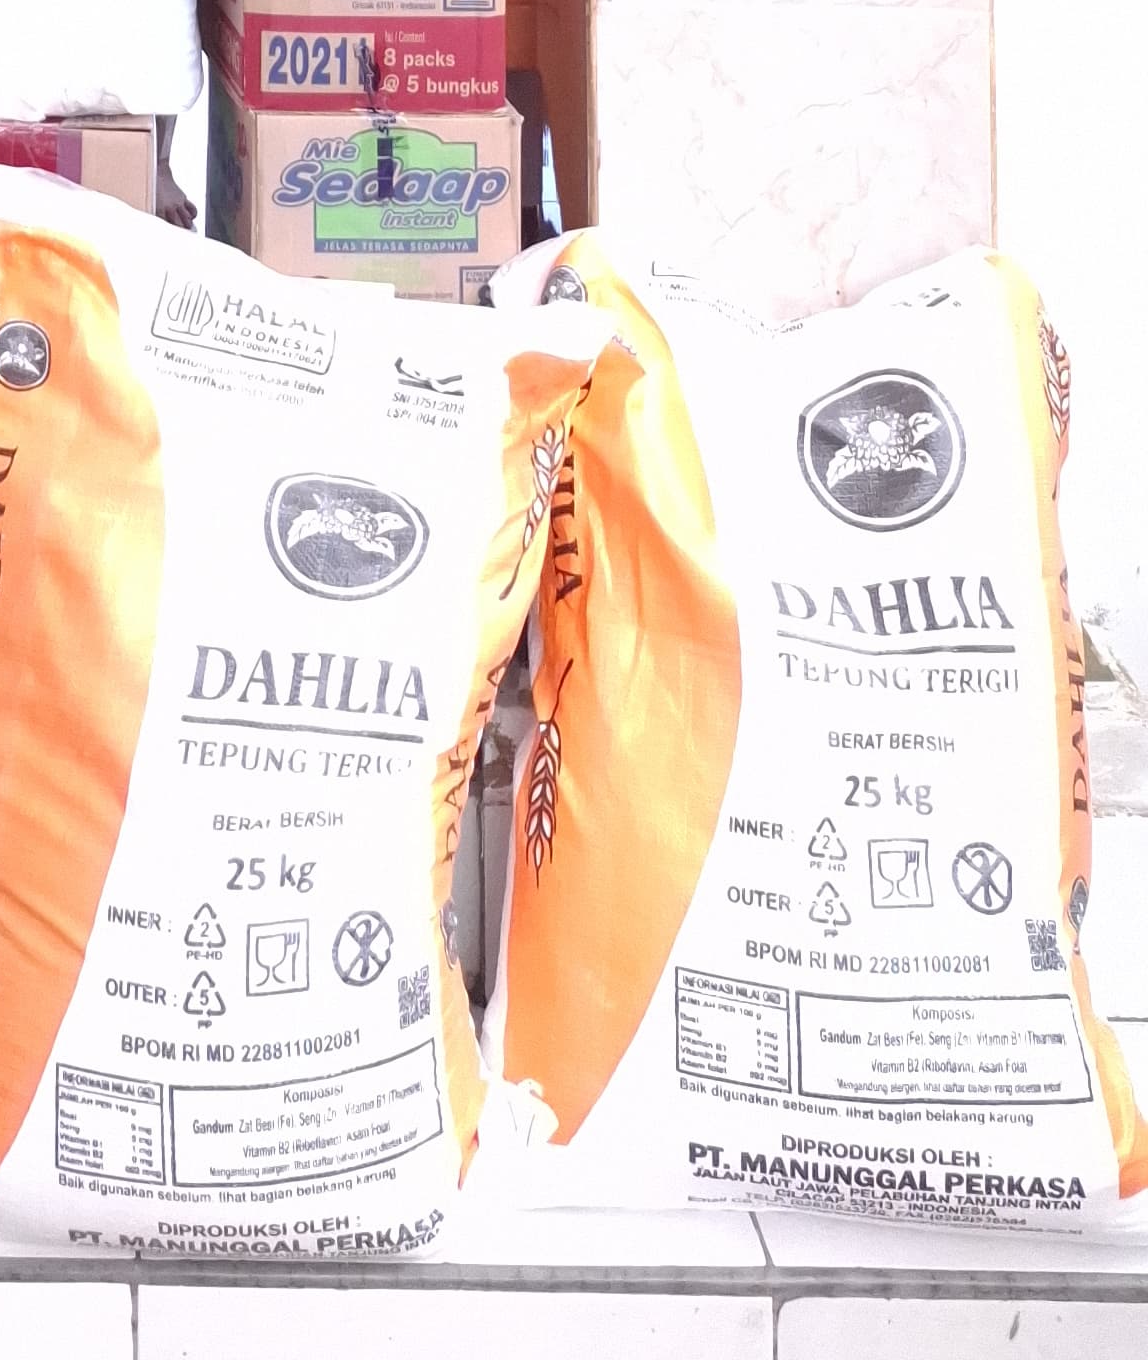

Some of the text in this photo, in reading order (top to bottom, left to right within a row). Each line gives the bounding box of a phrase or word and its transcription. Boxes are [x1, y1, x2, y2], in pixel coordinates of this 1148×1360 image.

[383, 48, 456, 70] 8 packs
[406, 74, 419, 93] 5
[426, 76, 500, 97] bungkus
[302, 137, 360, 161] Mie
[380, 209, 459, 230] Instant
[323, 240, 470, 252] JELAS TERASA SEDAPNYA
[214, 319, 325, 356] INDONESIA
[771, 576, 1015, 636] DAHLIA
[187, 644, 429, 721] DAHLIA
[778, 652, 1019, 693] TEPUNG TERIGU
[828, 731, 955, 753] BERAT BERSIH
[178, 738, 307, 774] TEPUNG
[844, 773, 933, 816] 25 kg
[279, 810, 344, 829] BERSIH
[728, 815, 784, 841] INNER
[821, 834, 831, 851] 2
[226, 853, 317, 894] 25 kg
[727, 885, 791, 912] OUTER
[824, 899, 834, 916] 5
[107, 904, 162, 932] INNER
[201, 921, 210, 938] 2
[745, 939, 990, 975] BPOM RI MD 228811002081
[105, 977, 167, 1007] OUTER
[199, 989, 210, 1007] 5
[120, 1028, 361, 1064] BPOM RI MD 228811002081
[819, 1027, 862, 1045] Gandum
[929, 1031, 952, 1049] Seng
[907, 1058, 919, 1073] B2
[978, 1059, 1003, 1074] Asam
[679, 1076, 707, 1095] Baik
[711, 1082, 779, 1108] digunakan
[845, 1106, 874, 1121] lihat
[877, 1108, 922, 1125] bagian
[925, 1109, 986, 1126] belakang
[989, 1110, 1034, 1127] karung
[193, 1119, 233, 1135] Gandum
[781, 1133, 981, 1168] DIPRODUKSI OLEH
[688, 1140, 1086, 1199] PT. MANUNGGAL PERKASA
[58, 1172, 85, 1191] Baik
[87, 1178, 155, 1200] digunakan
[218, 1189, 247, 1204] lihat
[250, 1188, 294, 1205] bagian
[296, 1179, 353, 1198] belakang
[356, 1167, 397, 1186] karung
[692, 1167, 745, 1182] JALAN
[749, 1174, 792, 1189] LAUT
[849, 1187, 950, 1205] PELABUHAN
[954, 1195, 1031, 1209] TANJUNG
[1035, 1198, 1082, 1210] INTAN
[775, 1188, 846, 1204] CILACAP
[908, 1203, 997, 1217] INDONESIA
[158, 1216, 350, 1239] DIPRODUKSI OLEH
[68, 1228, 111, 1248] PT.
[120, 1233, 309, 1255] MANUNGGAL
